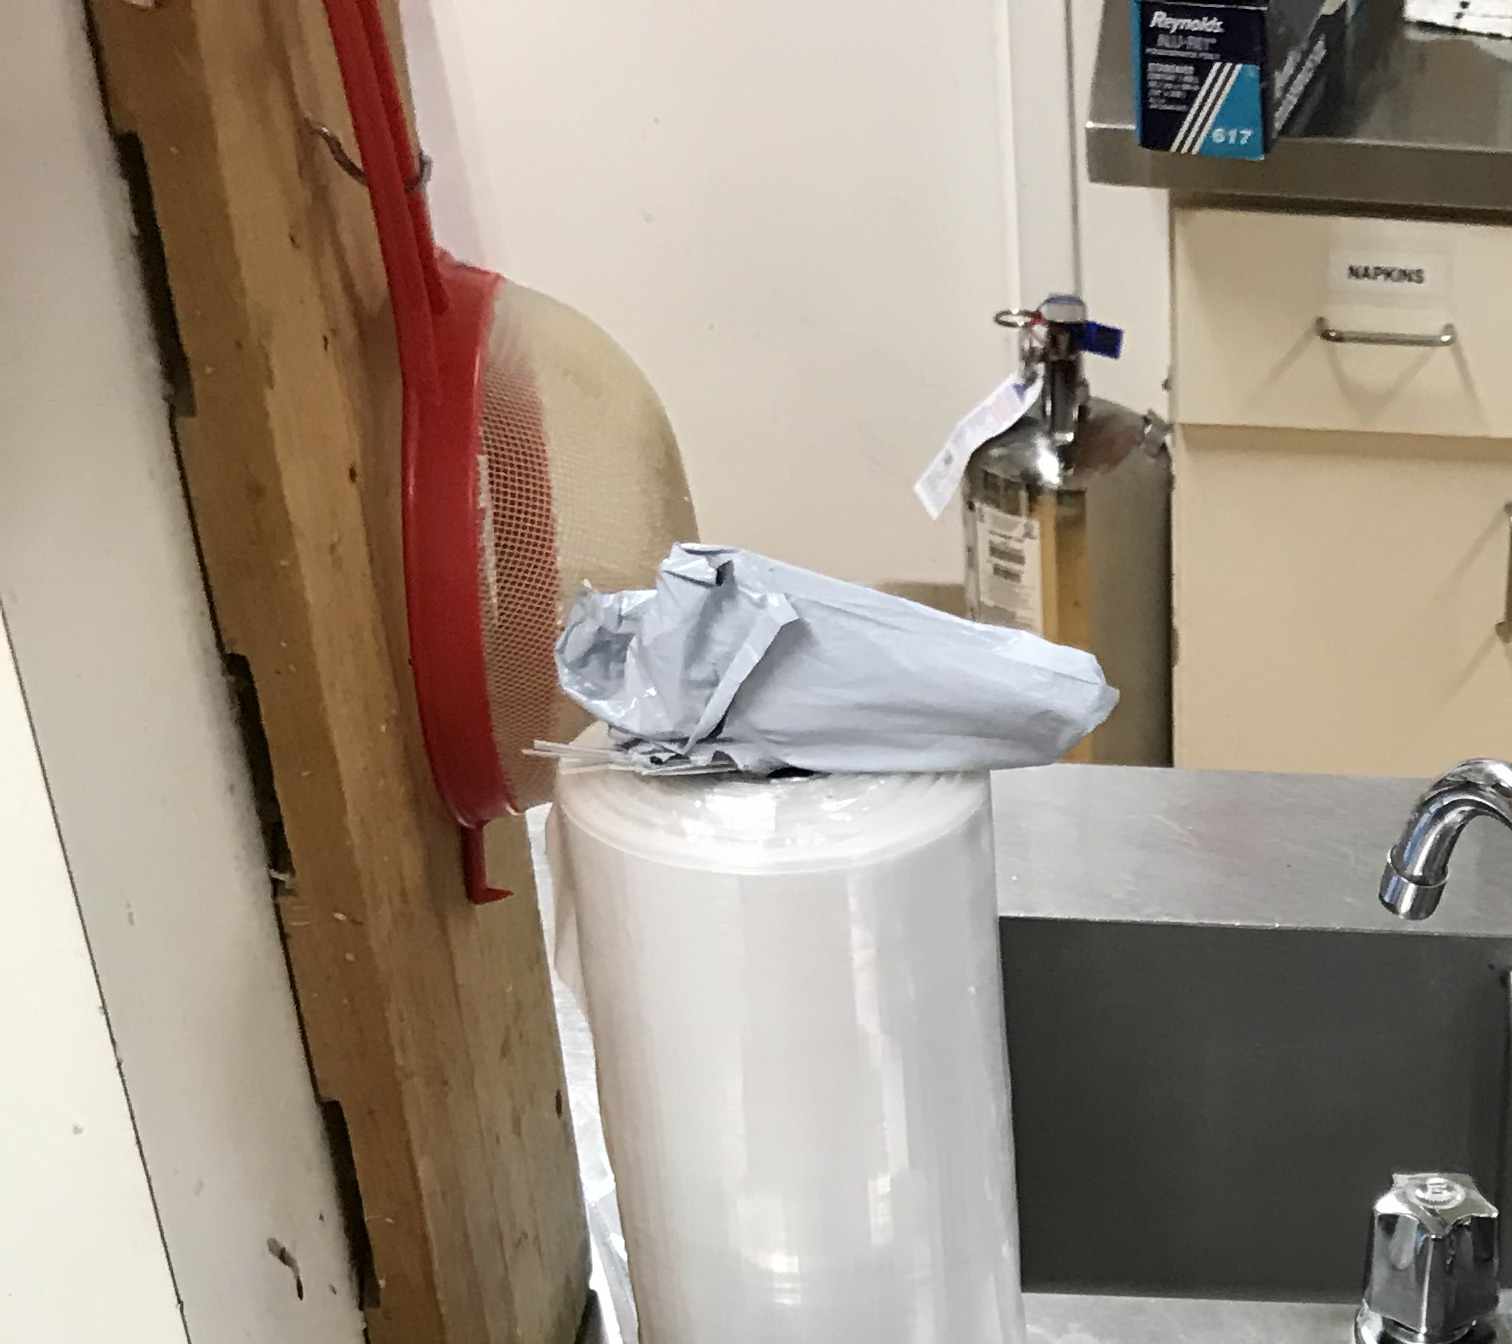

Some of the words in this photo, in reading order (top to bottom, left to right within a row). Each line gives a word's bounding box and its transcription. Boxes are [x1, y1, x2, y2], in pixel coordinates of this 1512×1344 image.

[1149, 10, 1225, 33] Reynolds
[1211, 127, 1253, 144] 617
[1347, 264, 1425, 284] NAPKINS
